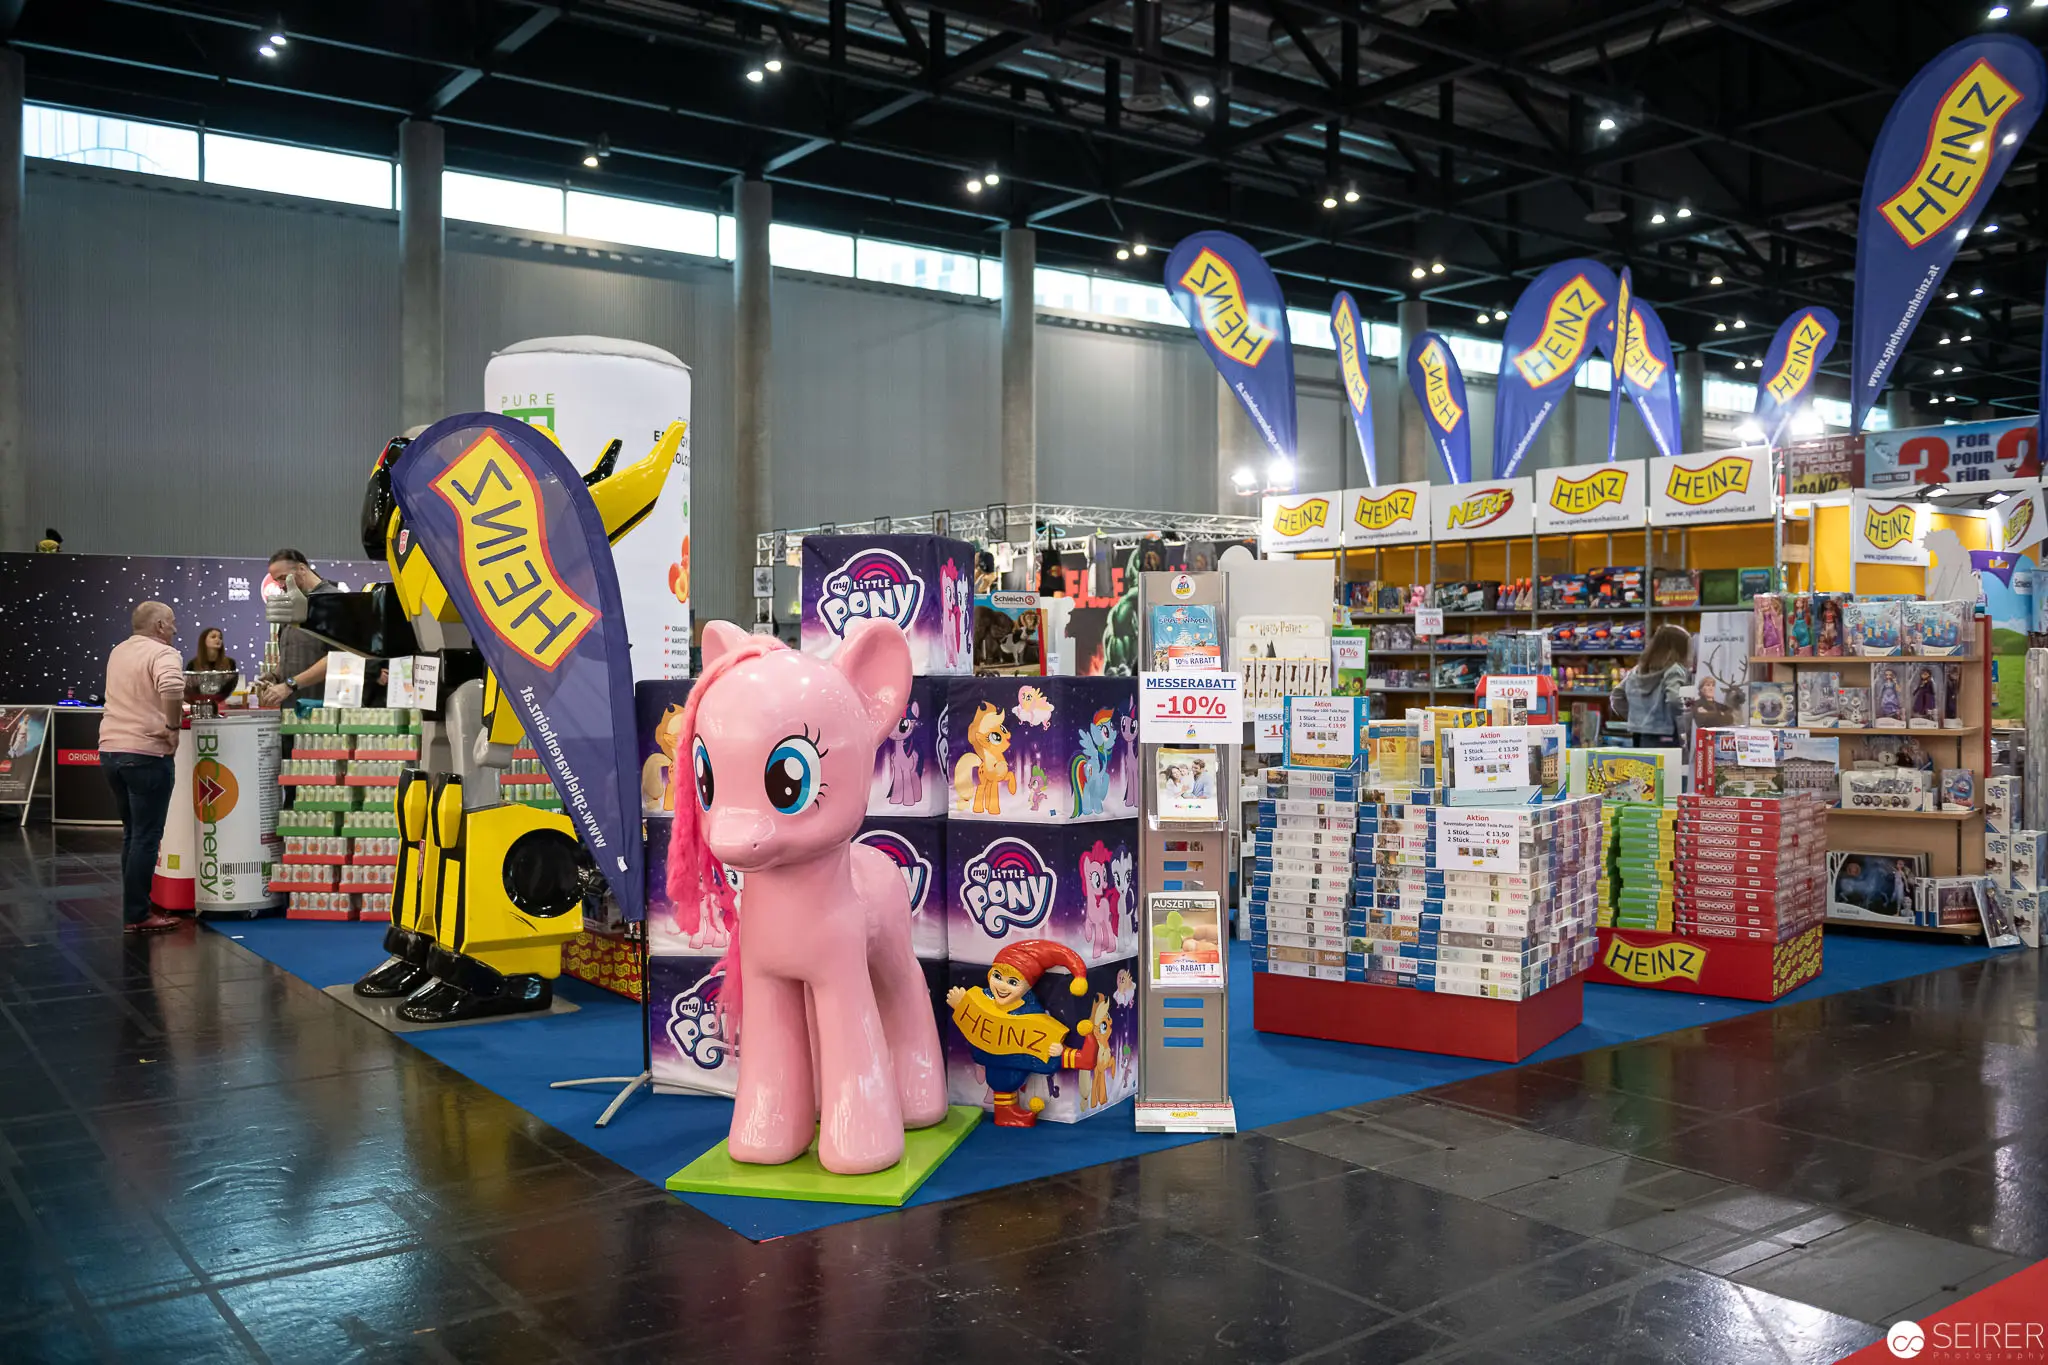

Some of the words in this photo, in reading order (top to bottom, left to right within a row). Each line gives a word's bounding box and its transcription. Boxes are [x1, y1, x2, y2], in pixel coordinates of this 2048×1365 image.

[1897, 80, 2007, 236] HEINZ
[1867, 263, 1941, 389] www.spielwarenheinz.at
[1523, 287, 1597, 382] HEINZ
[1773, 323, 1822, 400] HEINZ
[501, 392, 556, 409] PURE
[1956, 432, 1990, 449] FOR
[1952, 450, 1995, 466] POUR
[1956, 466, 1991, 482] FÜR
[1673, 465, 1744, 498] HEINZ
[1556, 477, 1620, 508] HEINZ
[1359, 496, 1409, 525] HEINZ
[1447, 488, 1514, 530] NERF
[1665, 504, 1756, 518] www.spielwarenheinz.at
[1278, 505, 1323, 531] HEINZ
[1549, 513, 1630, 527] www.spielwarenheinz.at
[1868, 514, 1911, 543] HEINZ
[228, 577, 250, 585] FULL
[832, 579, 848, 592] my
[994, 595, 1025, 603] Schleich
[824, 583, 916, 632] PONY
[1190, 656, 1216, 665] RABATT
[1146, 678, 1237, 689] MESSERABATT
[1494, 687, 1529, 697] -10%
[1156, 695, 1226, 715] -10%
[1264, 724, 1284, 736] -10
[68, 752, 100, 761] ORIGINA
[1309, 787, 1327, 797] 1000
[1700, 799, 1737, 807] MONOPOLY
[1701, 811, 1738, 820] MONOPOLY
[1701, 824, 1738, 833] MONOPOLY
[1699, 837, 1736, 846] MONOPOLY
[1699, 850, 1736, 859] MONOPOLY
[972, 867, 988, 881] my
[1696, 863, 1733, 872] MONOPOLY
[1699, 876, 1736, 885] MONOPOLY
[967, 875, 1047, 920] PONY
[1695, 889, 1732, 898] MONOPOLY
[1153, 899, 1192, 909] AUSZEIT
[1697, 902, 1735, 911] MONOPOLY
[1698, 914, 1735, 923] MONOPOLY
[1699, 927, 1736, 937] MONOPOLY
[1610, 944, 1695, 976] HEINZ
[580, 963, 600, 979] HEINZ
[1165, 964, 1179, 973] 10%
[1180, 963, 1206, 972] RABATT
[681, 1002, 699, 1014] my
[958, 1010, 1050, 1053] HEINZ
